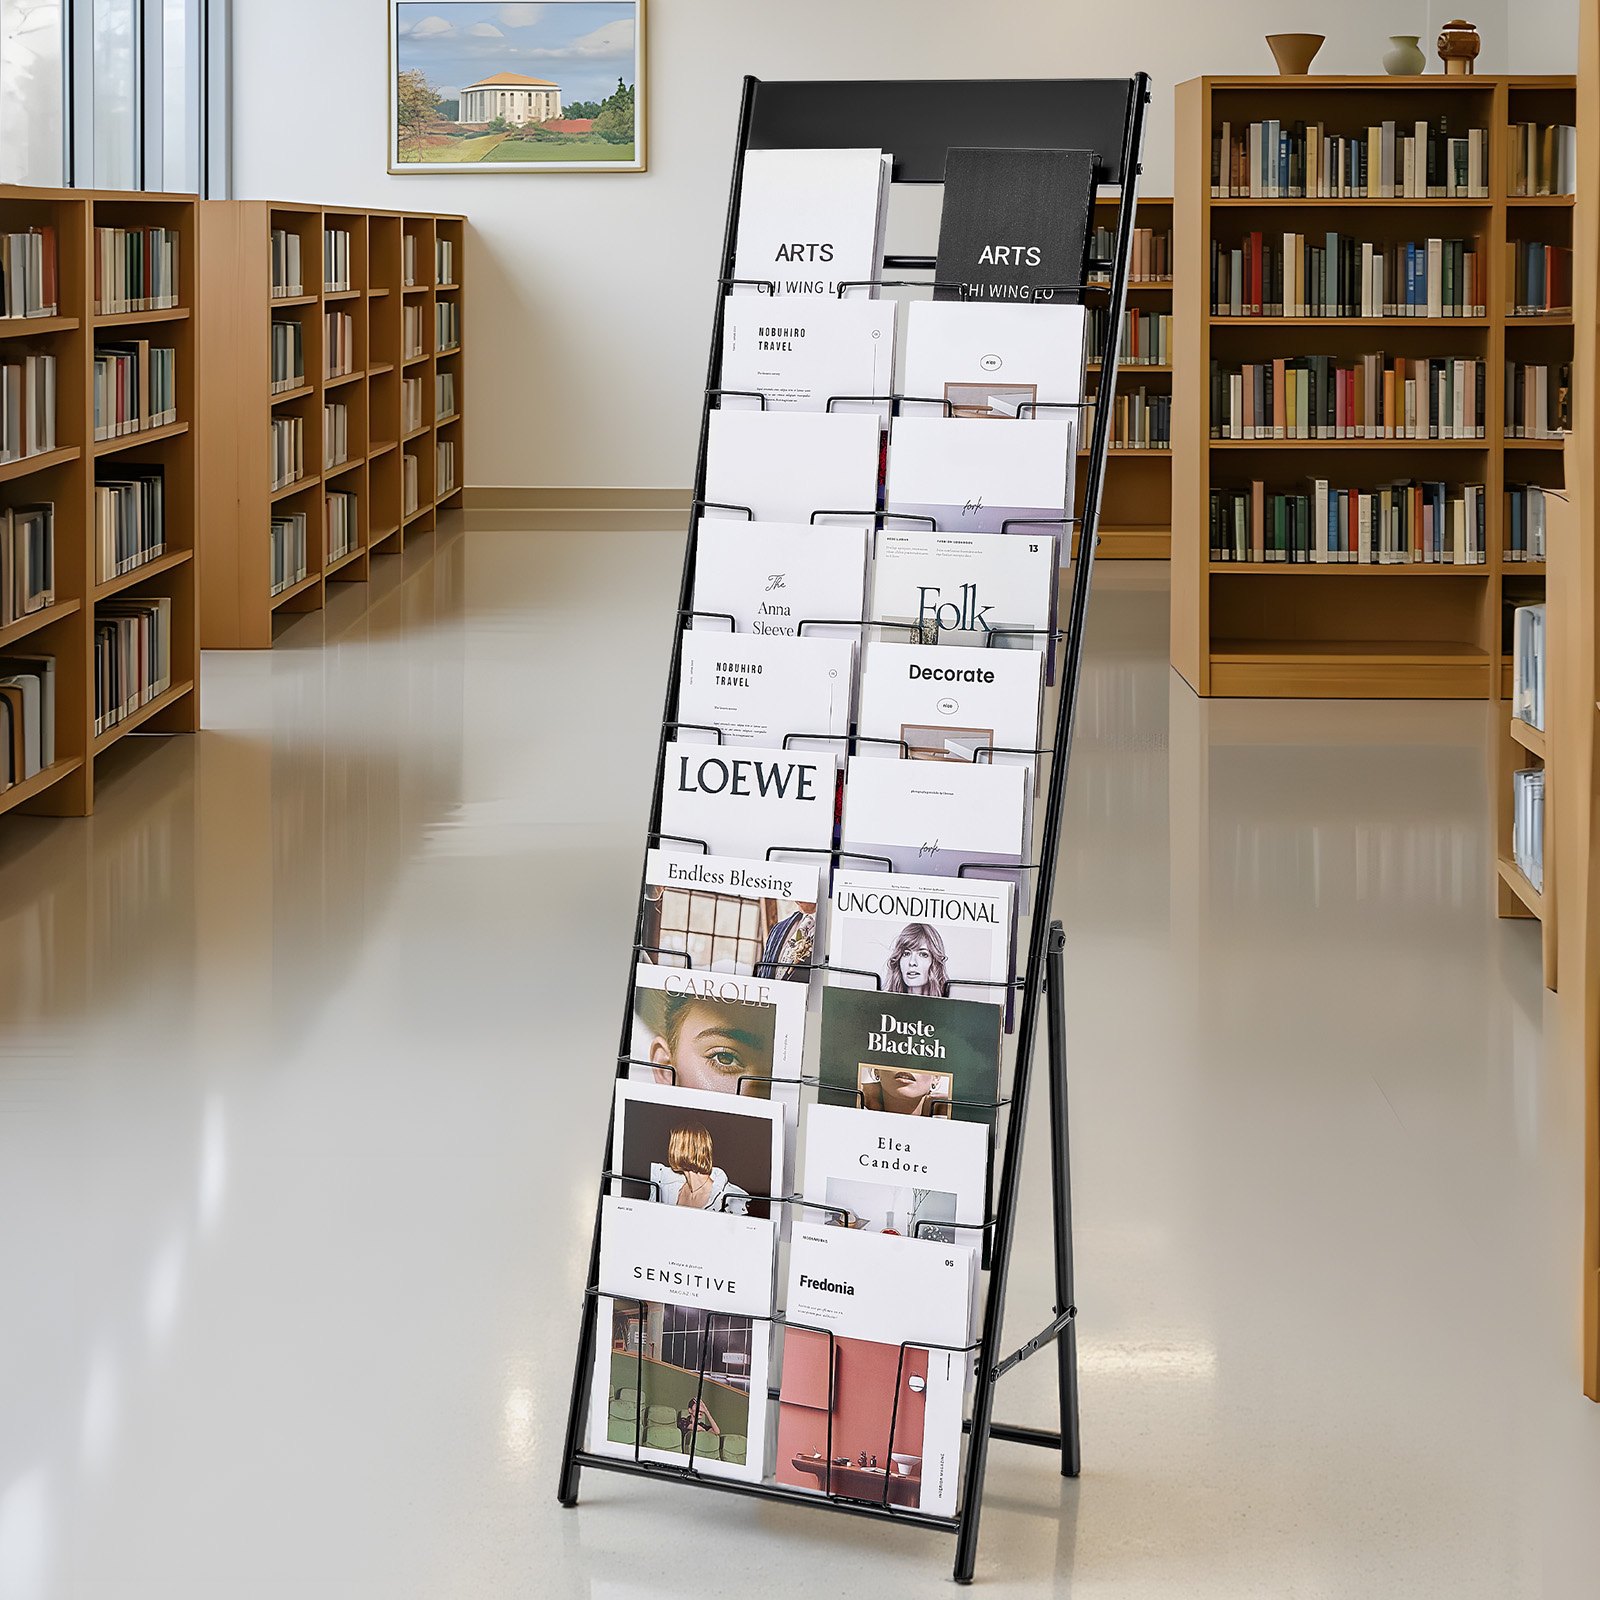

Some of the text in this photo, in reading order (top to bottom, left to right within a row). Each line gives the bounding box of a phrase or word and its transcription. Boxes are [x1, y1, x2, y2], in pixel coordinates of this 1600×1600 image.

[775, 243, 834, 262] ARTS
[977, 245, 1041, 267] ARTS
[757, 280, 847, 294] CHI WING LO
[989, 284, 1030, 299] WING
[1033, 288, 1054, 300] LO
[758, 327, 806, 338] NOBUHIRO
[758, 341, 793, 351] TRAVEL
[1028, 544, 1039, 553] 13
[764, 573, 787, 592] The
[758, 601, 791, 617] Anna
[752, 620, 794, 637] Sleeve
[715, 662, 763, 674] NOBUHIRO
[909, 664, 995, 683] Decorate
[715, 676, 750, 687] TRAVEL
[678, 756, 817, 801] LOEWE
[668, 863, 793, 897] Endless Blessing
[837, 891, 1000, 924] UNCONDITIONAL
[664, 975, 771, 1008] CAROLE
[880, 1014, 935, 1038] Duste
[867, 1032, 946, 1059] Blackish
[877, 1137, 911, 1153] Elea
[858, 1154, 928, 1174] Candore
[944, 1259, 954, 1267] 05
[633, 1266, 736, 1294] SENSITIVE
[799, 1274, 855, 1296] Fredonia
